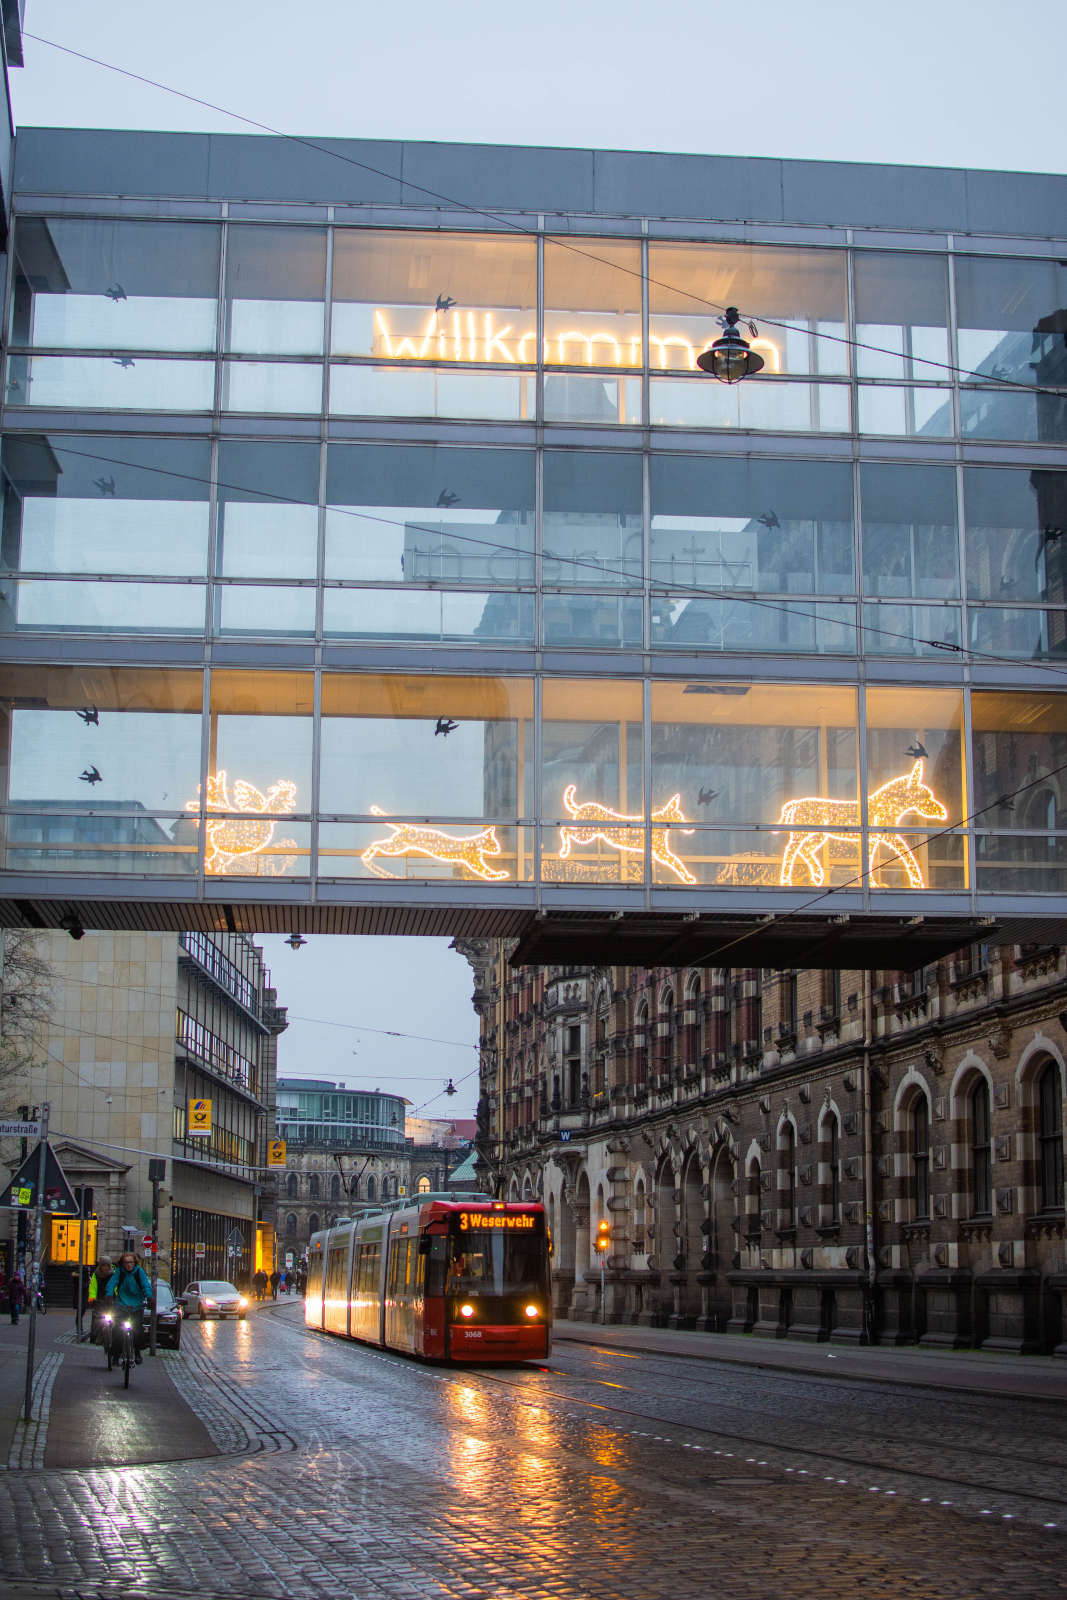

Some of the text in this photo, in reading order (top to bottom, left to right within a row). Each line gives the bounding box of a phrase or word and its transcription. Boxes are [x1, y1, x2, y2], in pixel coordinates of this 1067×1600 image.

[373, 308, 781, 374] Willkommn
[0, 1124, 38, 1134] turstraße
[560, 1131, 570, 1141] W
[460, 1213, 535, 1230] 3 Weserwehr
